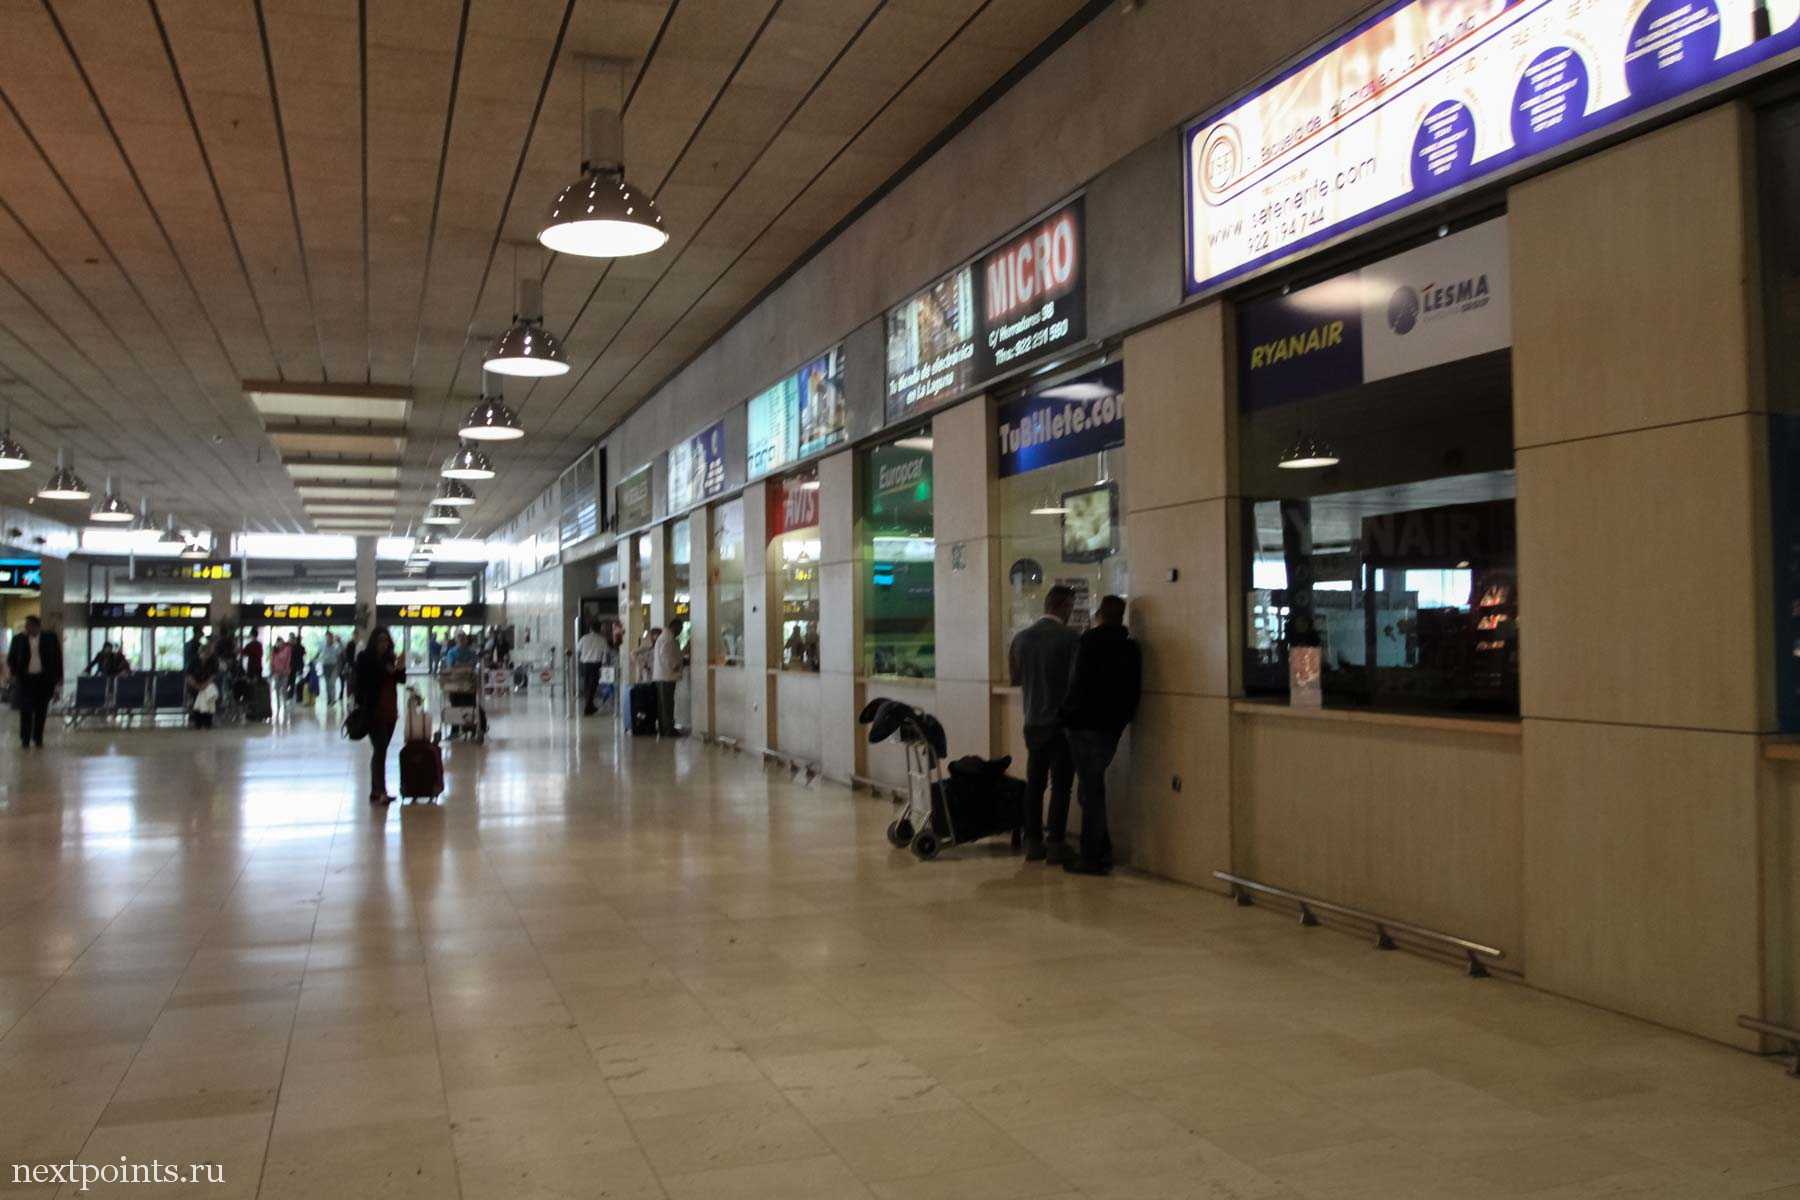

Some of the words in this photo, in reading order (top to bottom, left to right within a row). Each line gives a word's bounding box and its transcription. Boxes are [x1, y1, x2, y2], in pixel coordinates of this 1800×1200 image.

[987, 219, 1074, 321] MICRO
[1423, 274, 1489, 312] LESMA
[1251, 321, 1344, 370] RYANAIR
